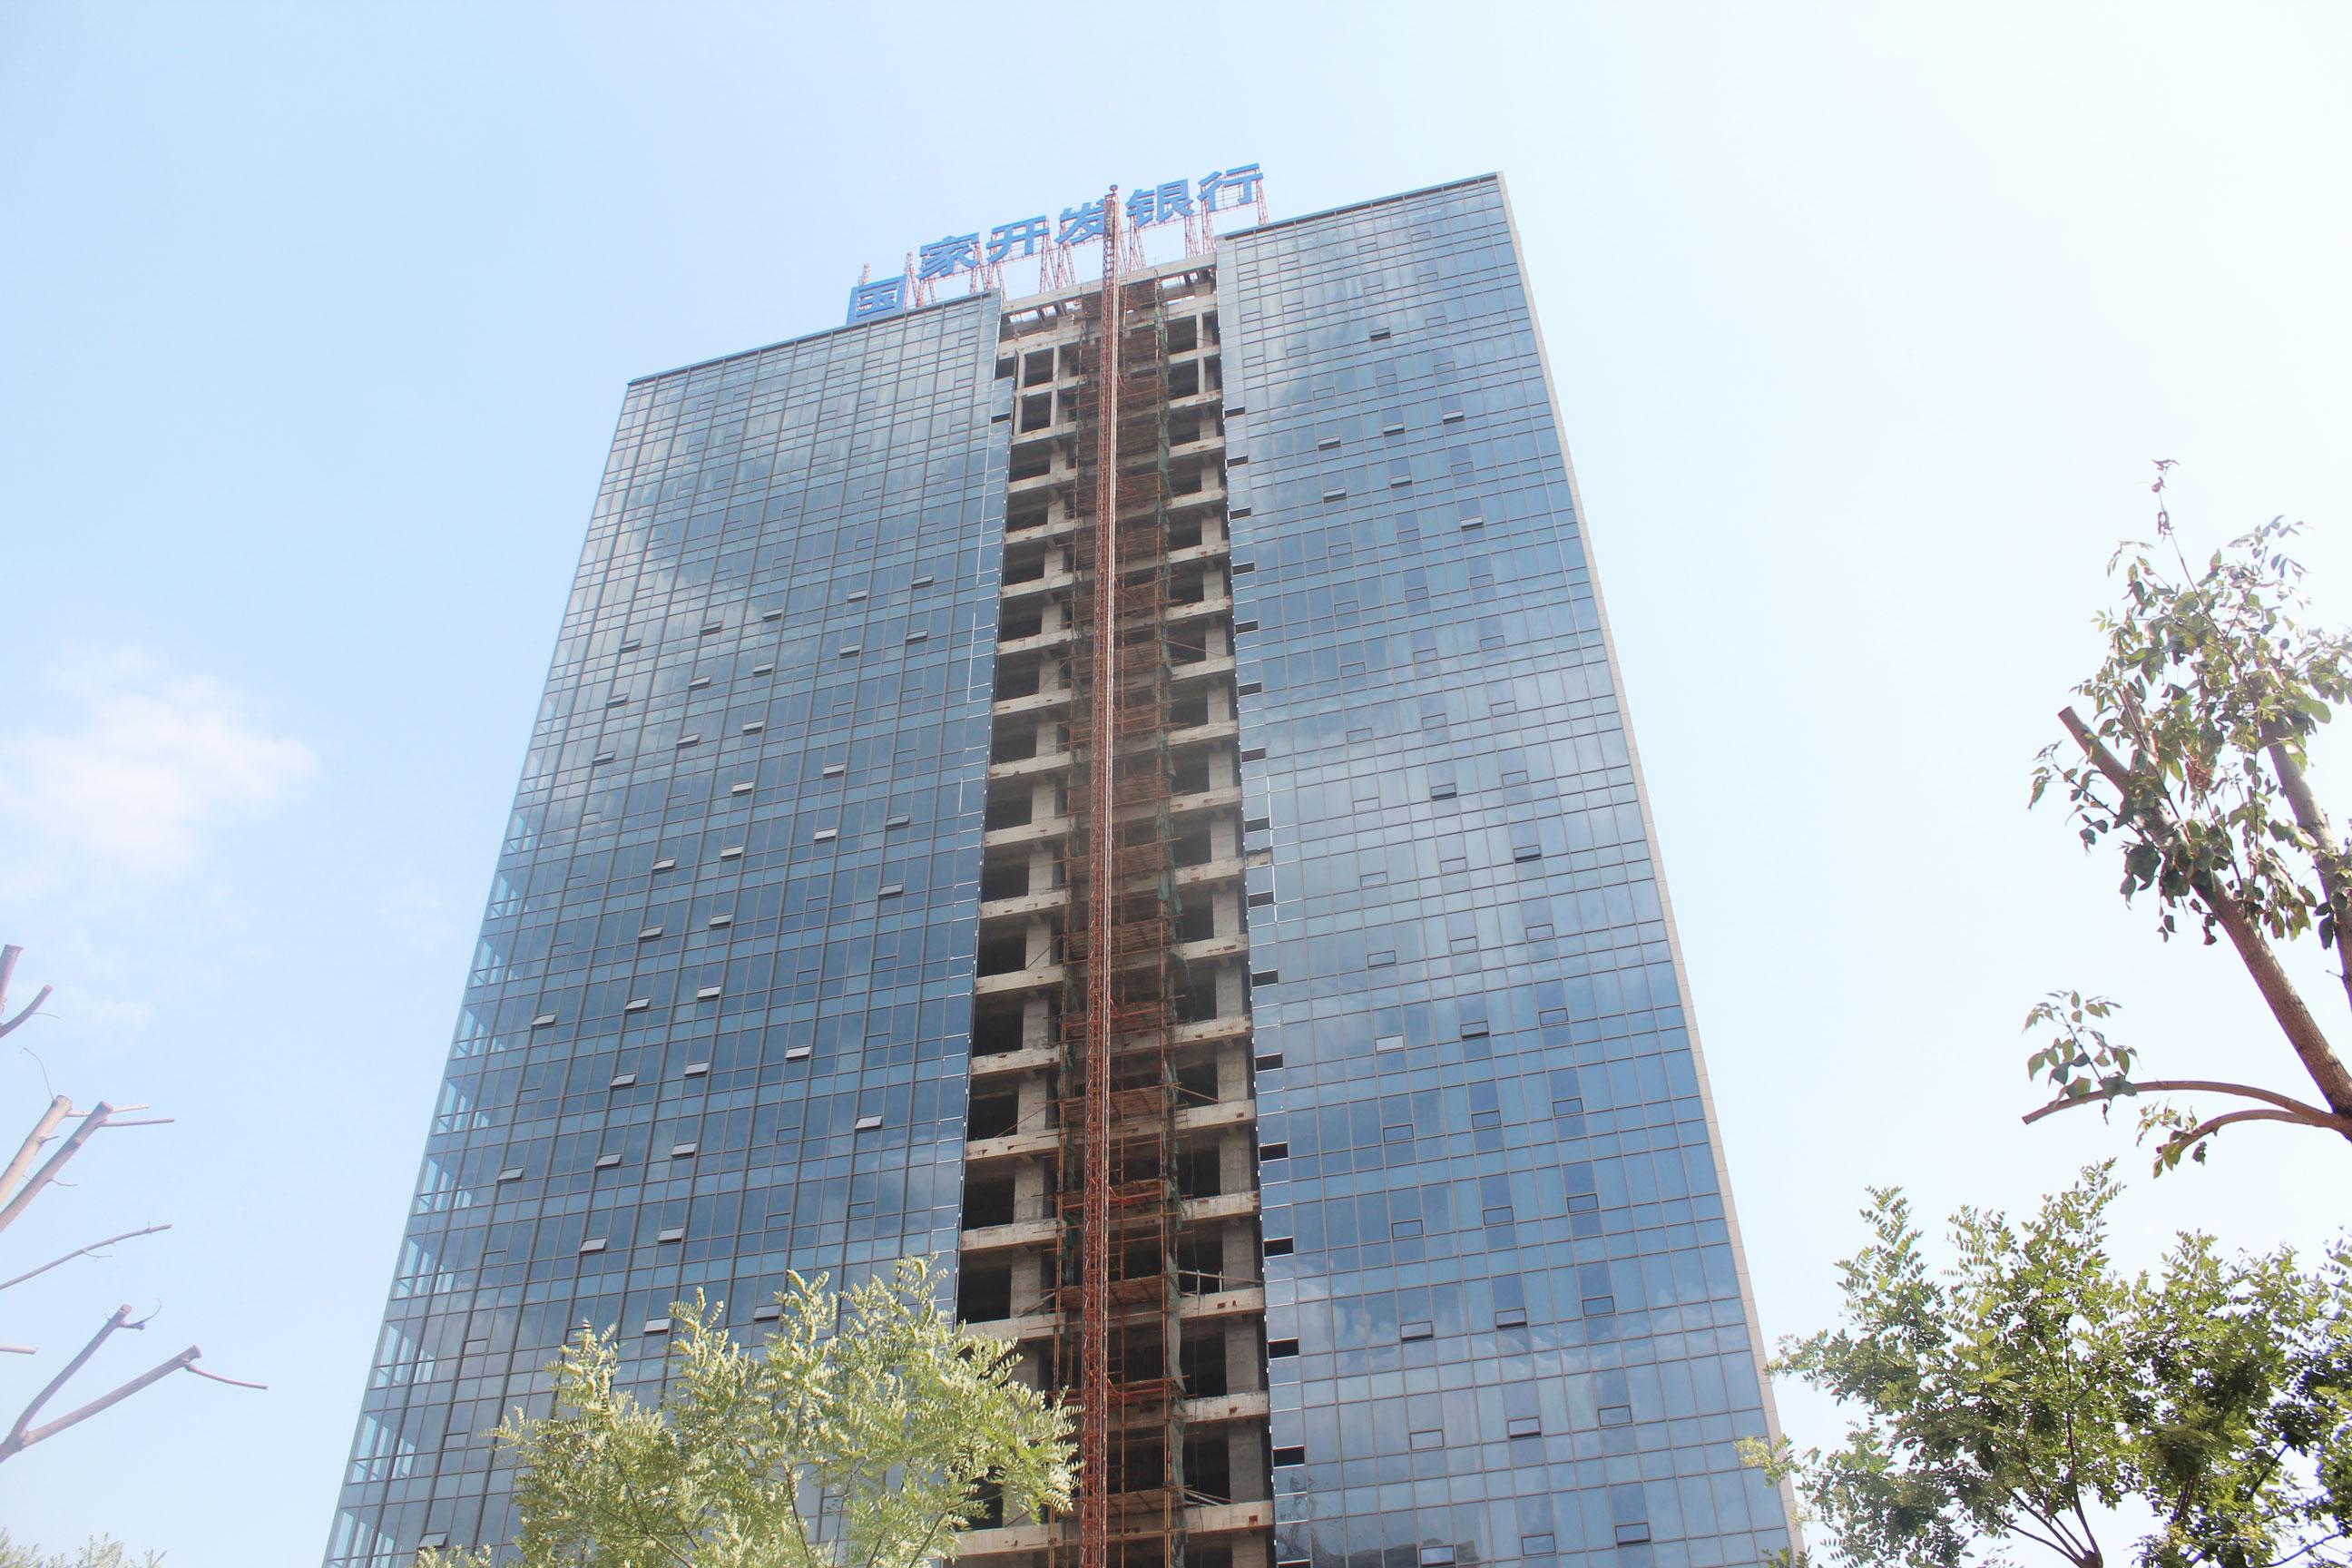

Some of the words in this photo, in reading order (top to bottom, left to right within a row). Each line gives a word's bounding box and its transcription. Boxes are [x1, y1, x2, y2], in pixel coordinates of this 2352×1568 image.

[846, 162, 1264, 325] 国家开发银行
